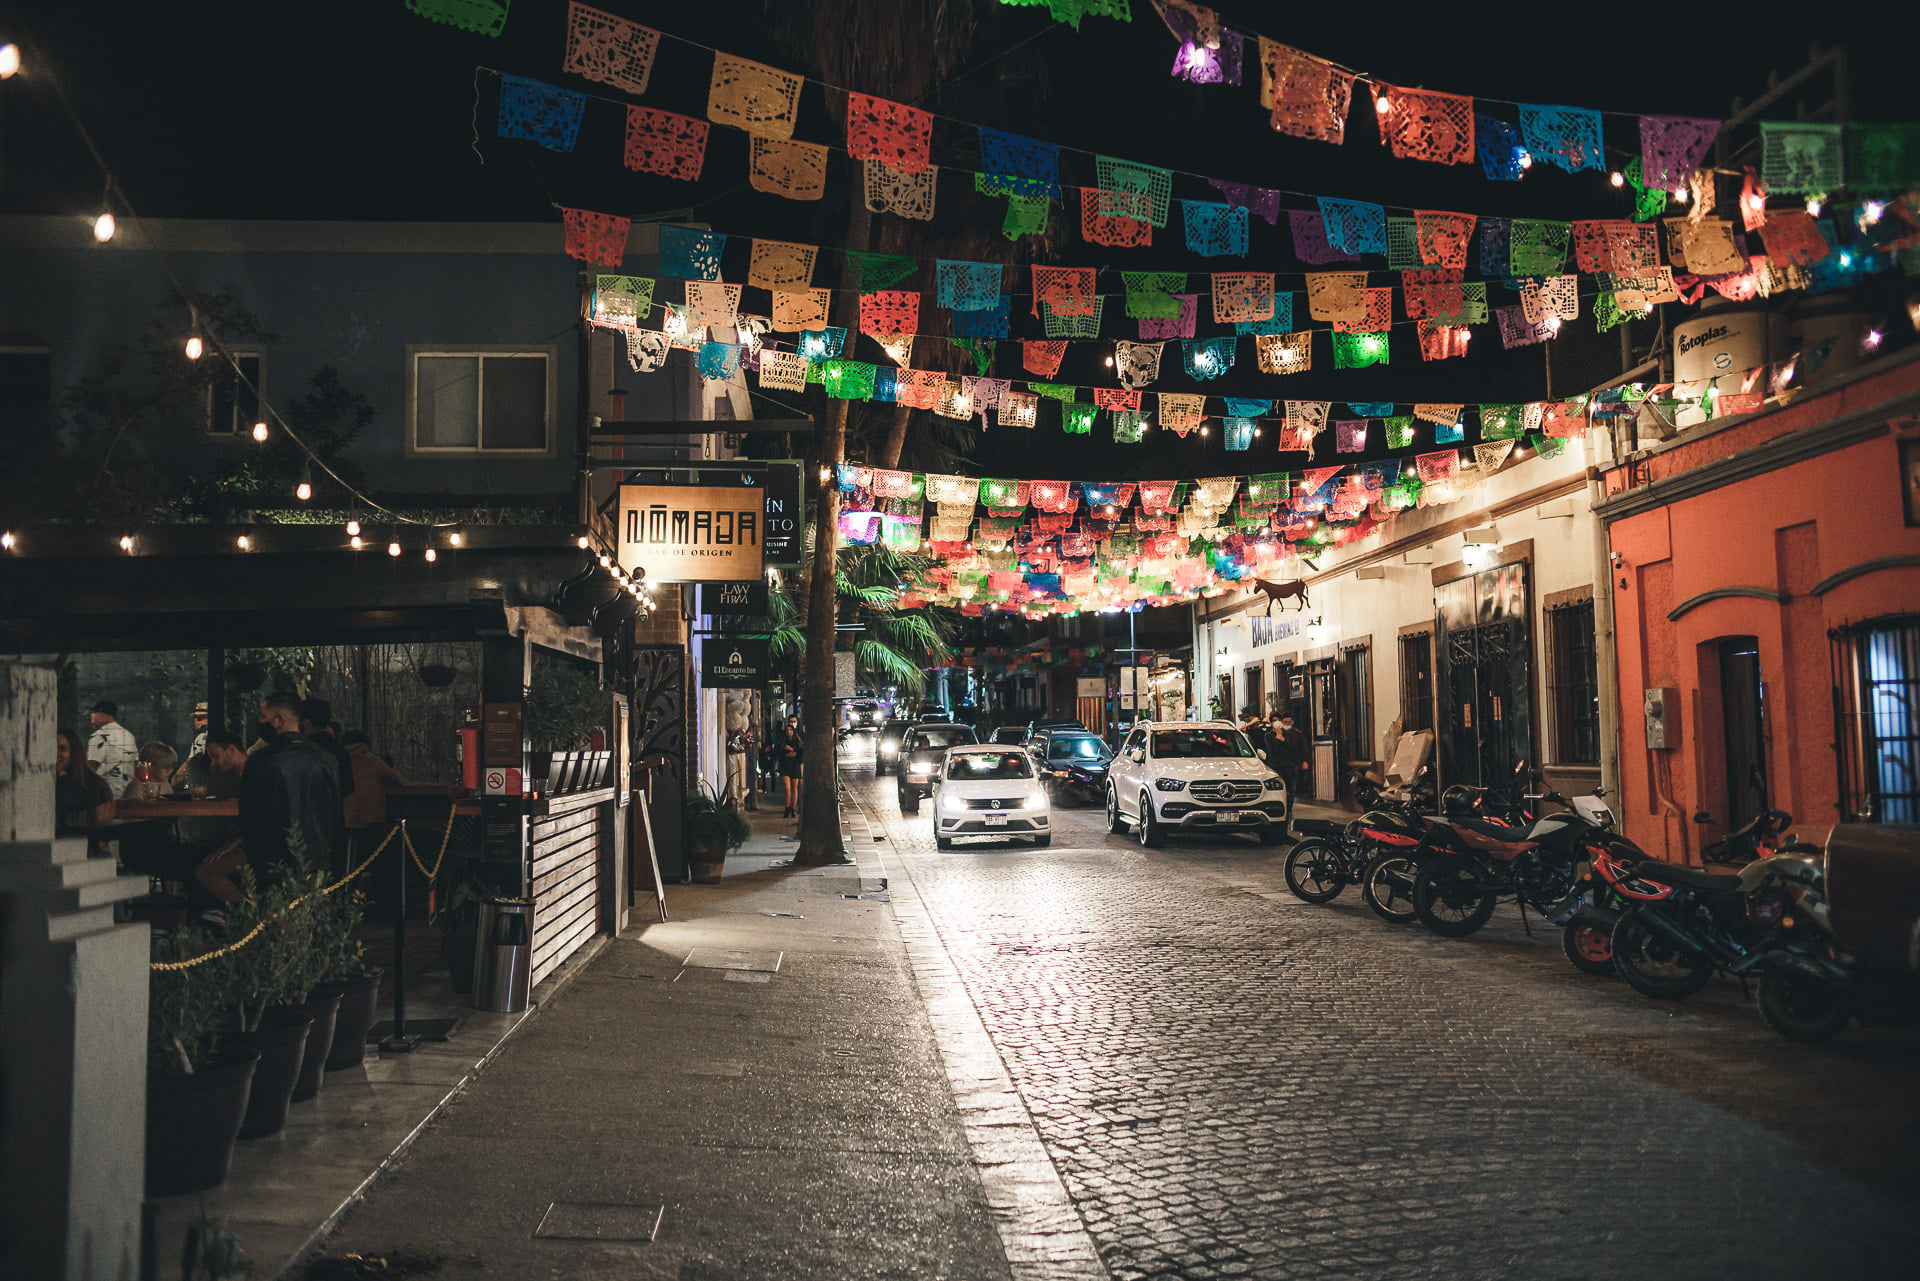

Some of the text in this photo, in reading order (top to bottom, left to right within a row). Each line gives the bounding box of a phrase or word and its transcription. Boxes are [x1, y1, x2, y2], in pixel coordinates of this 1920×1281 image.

[1679, 325, 1728, 356] Rotoplas
[691, 549, 733, 557] ORIGEN
[724, 584, 750, 594] LAW
[720, 594, 748, 604] FIRM
[713, 666, 721, 674] El
